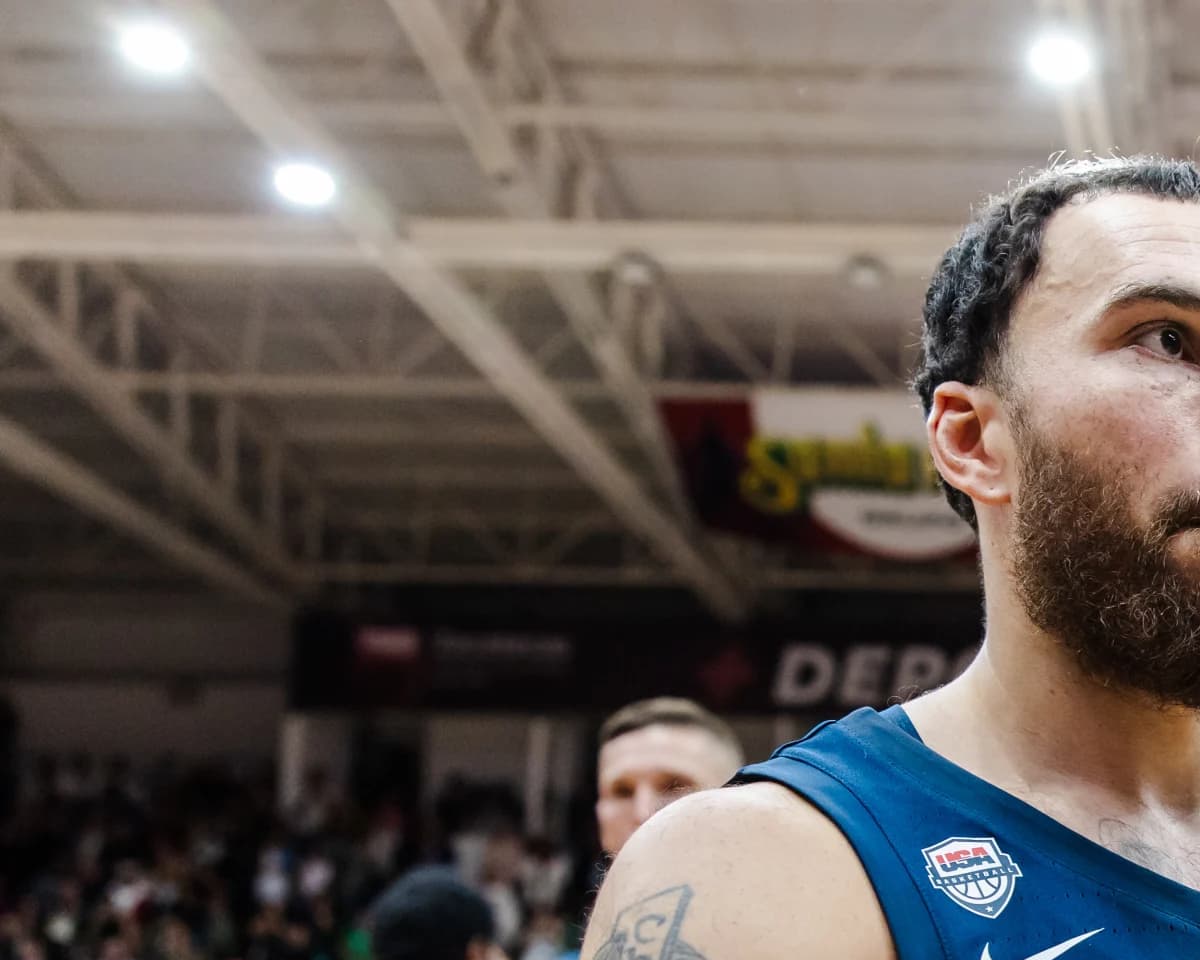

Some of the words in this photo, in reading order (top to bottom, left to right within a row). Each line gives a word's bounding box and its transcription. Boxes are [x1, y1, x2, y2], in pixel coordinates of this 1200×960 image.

[773, 642, 978, 706] DEP
[935, 846, 997, 872] USA
[935, 866, 1015, 885] BASKETBALL
